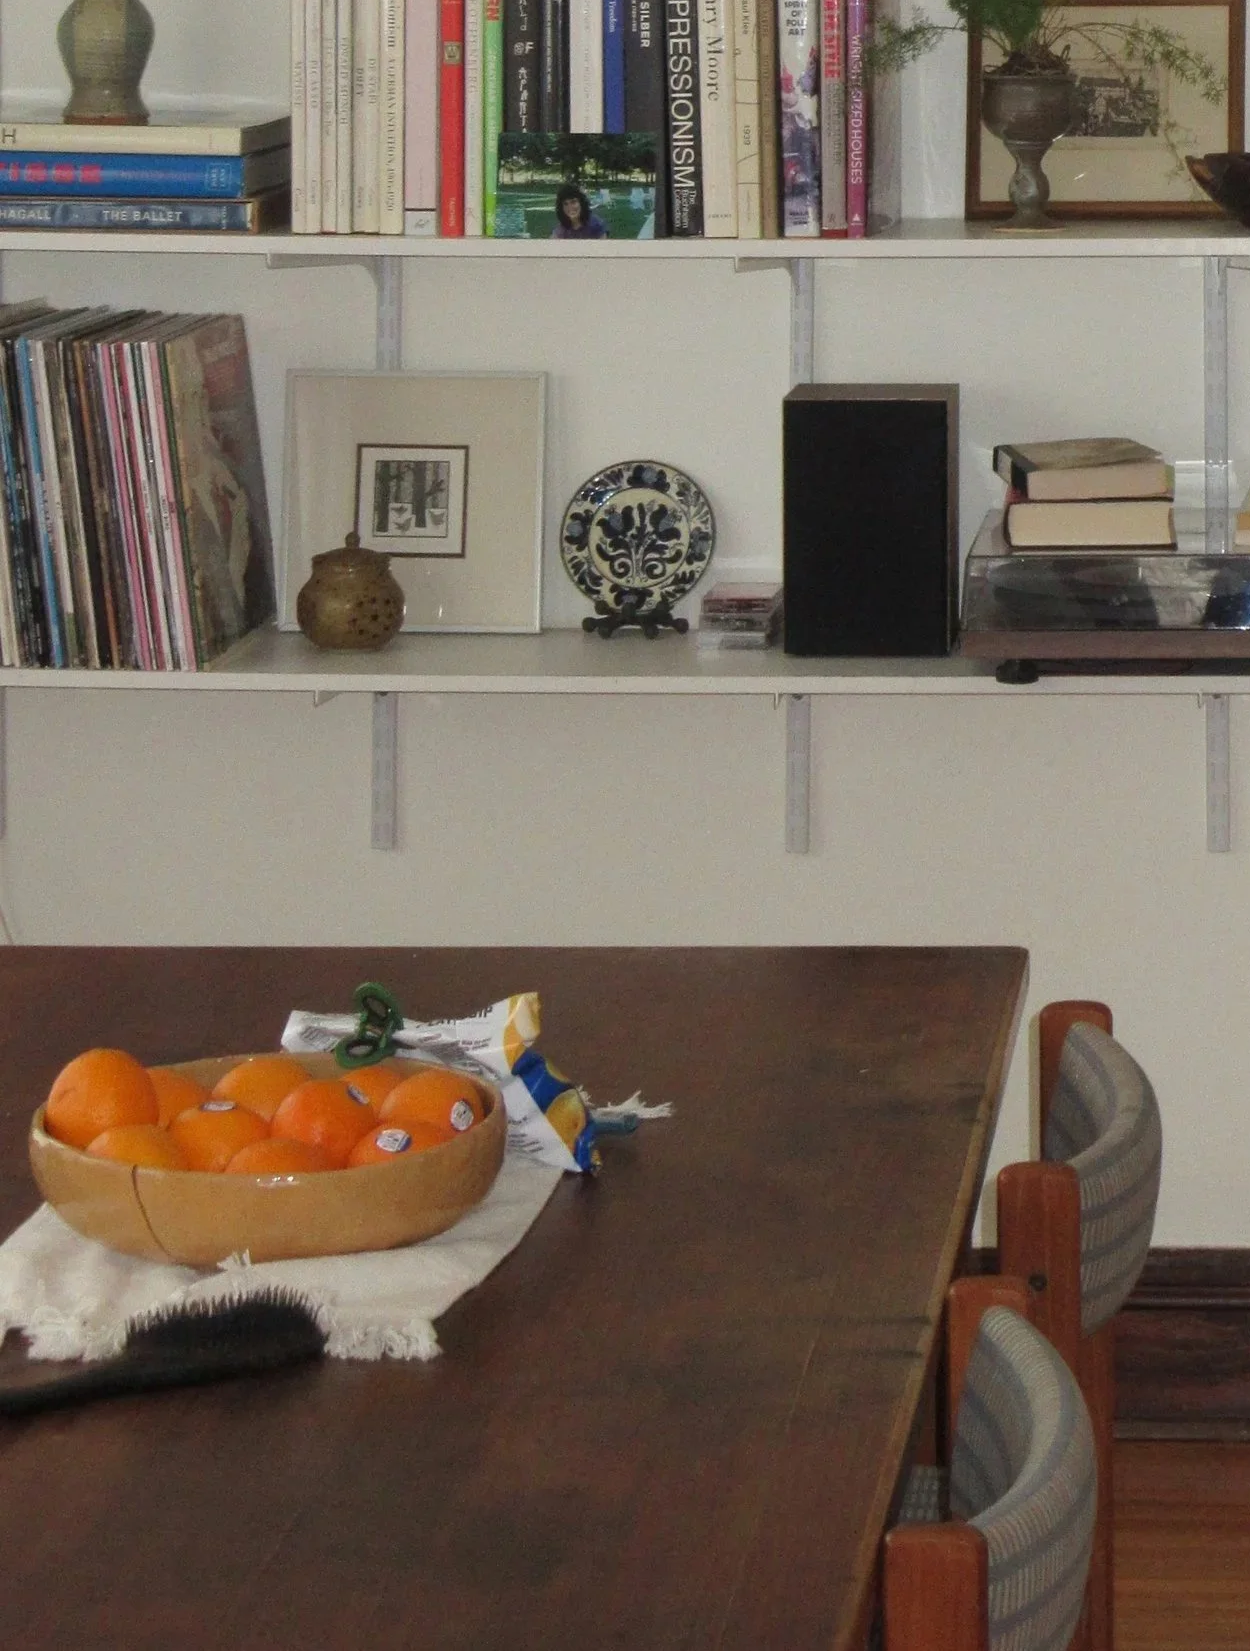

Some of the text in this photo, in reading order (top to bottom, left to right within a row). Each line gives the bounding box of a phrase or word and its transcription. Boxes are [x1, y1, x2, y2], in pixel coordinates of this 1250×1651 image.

[639, 1, 651, 48] SILBER
[742, 14, 751, 35] Klee
[706, 36, 725, 102] Moore
[743, 124, 752, 146] 1939
[851, 130, 863, 185] HOUSES
[675, 190, 684, 229] Collection
[689, 190, 697, 205] The
[103, 209, 127, 221] THE
[132, 210, 183, 222] BALLET
